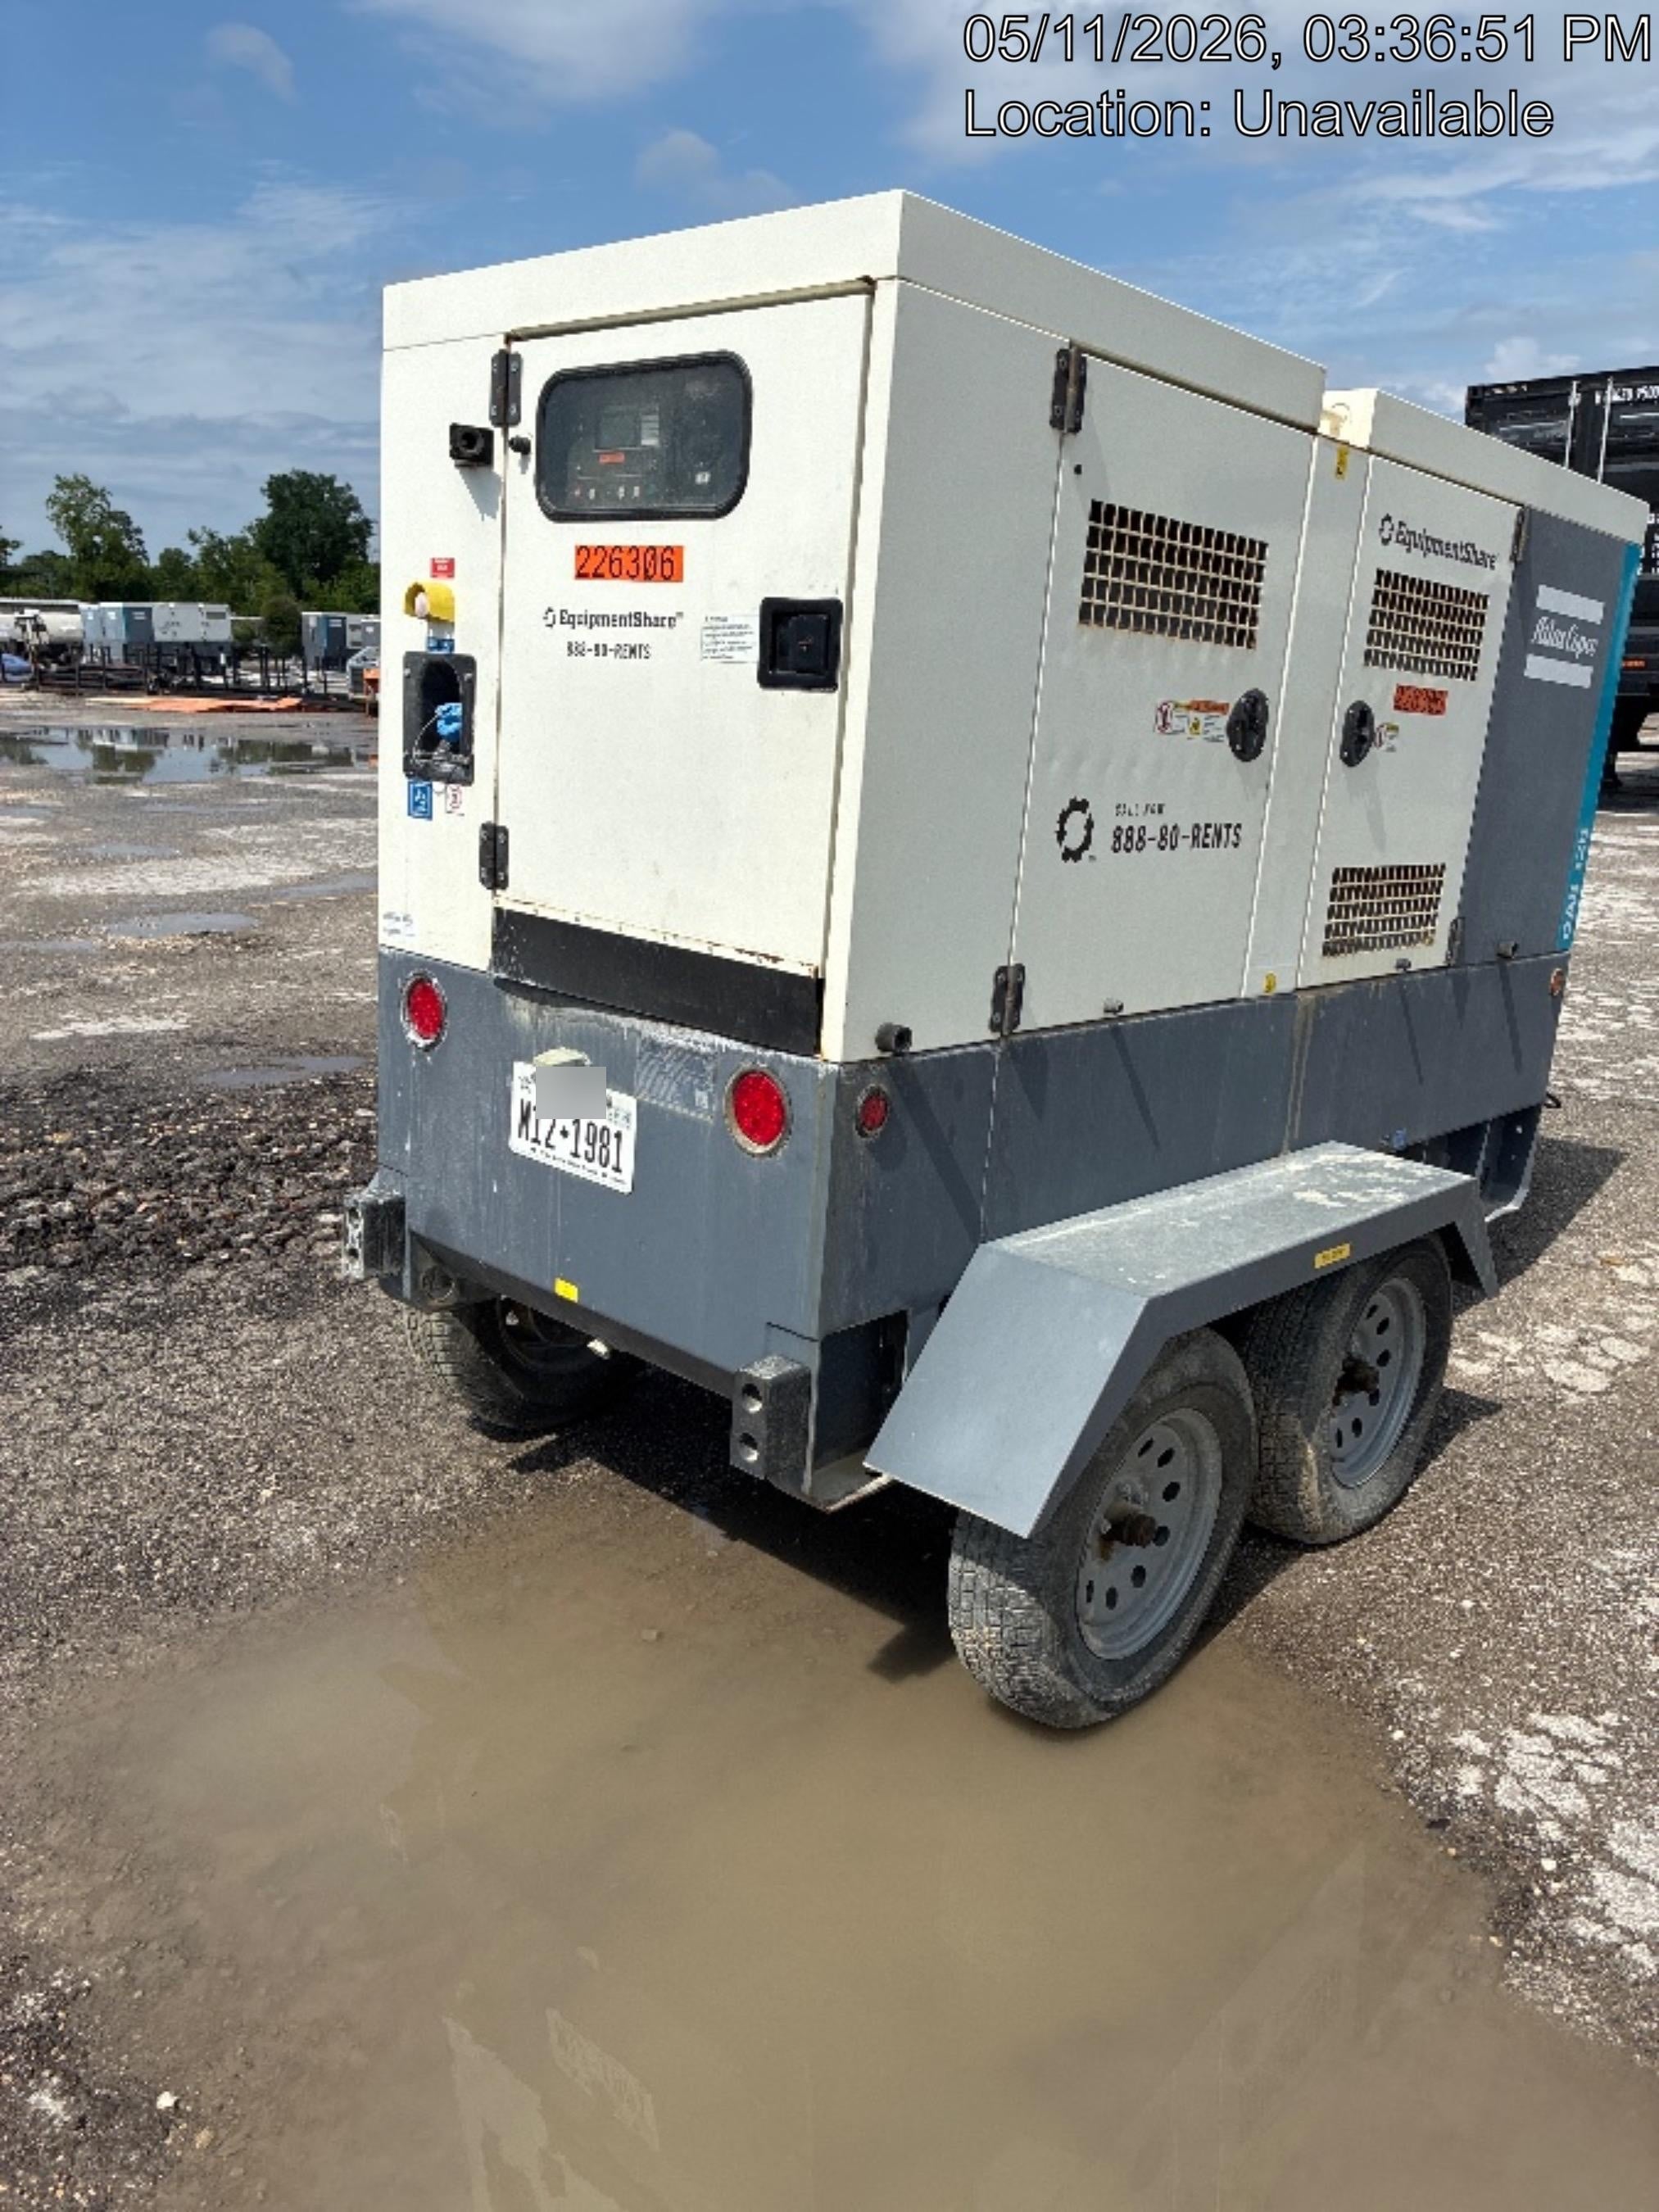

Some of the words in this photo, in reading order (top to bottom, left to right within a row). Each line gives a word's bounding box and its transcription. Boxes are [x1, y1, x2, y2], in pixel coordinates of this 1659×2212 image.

[574, 545, 674, 580] 226306
[1110, 822, 1243, 854] 888-80-RENTS
[569, 1119, 623, 1173] 1981
